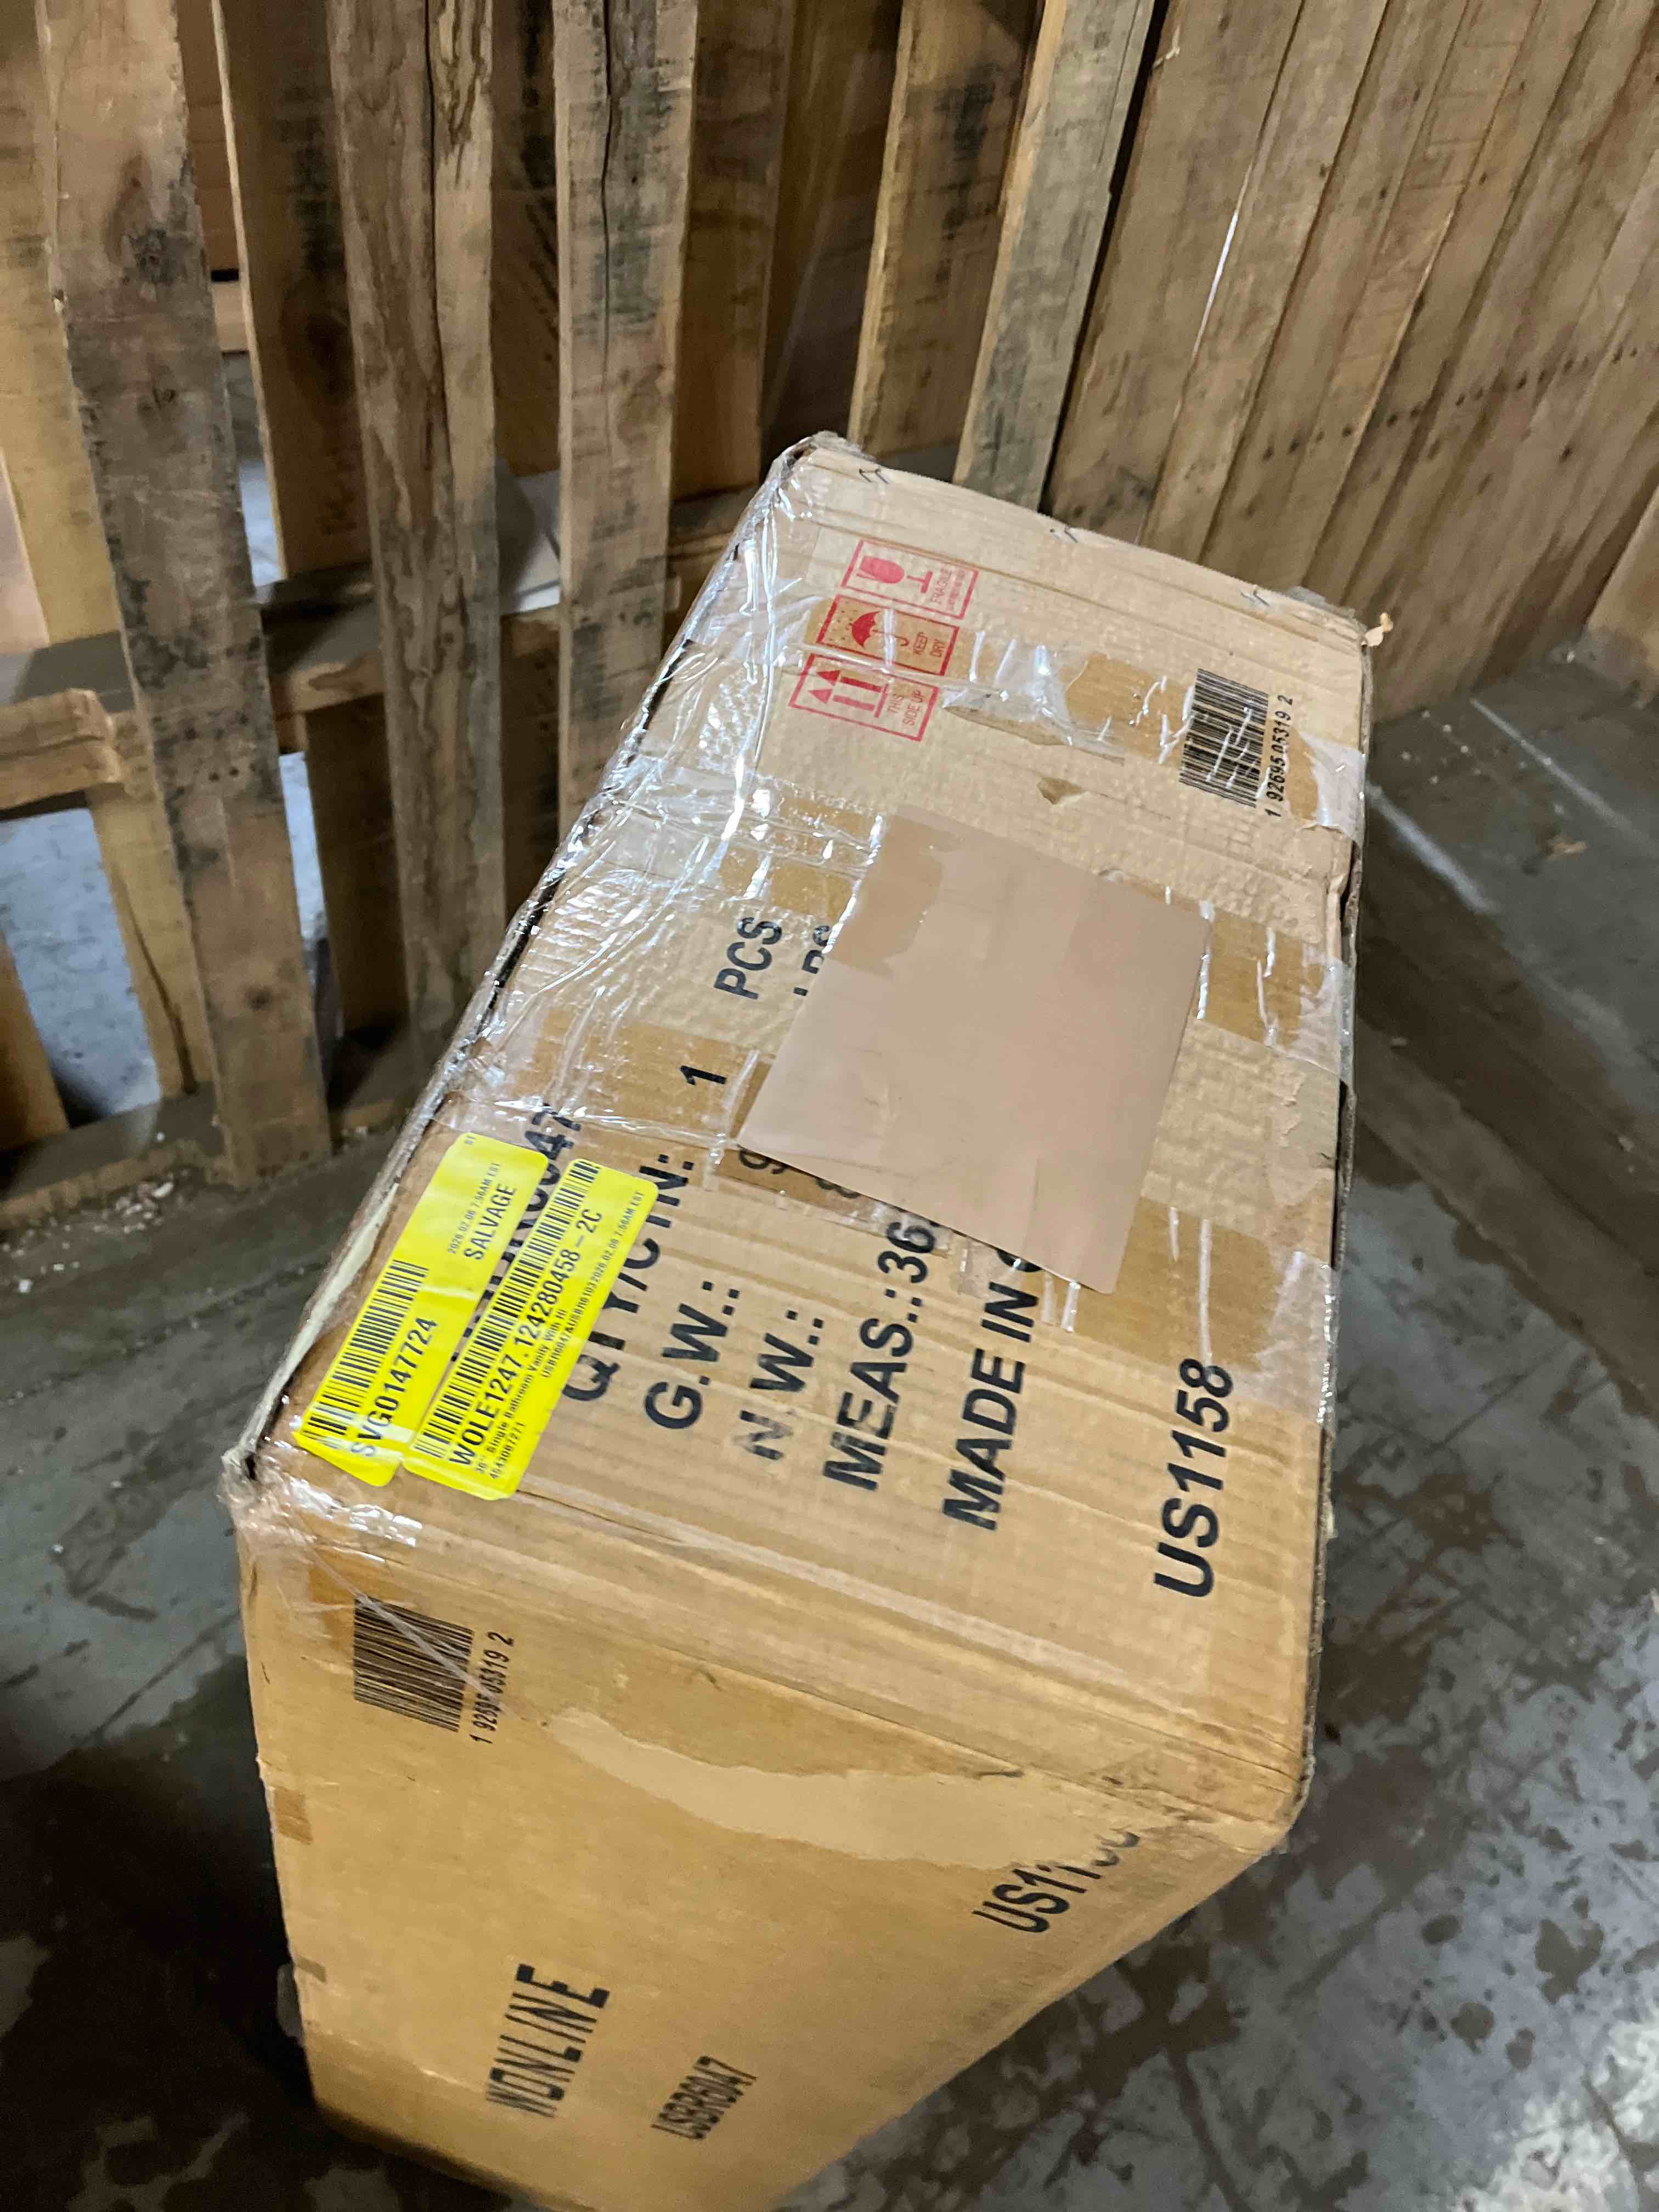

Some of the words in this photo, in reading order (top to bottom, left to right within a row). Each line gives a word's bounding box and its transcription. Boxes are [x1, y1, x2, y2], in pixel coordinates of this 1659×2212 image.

[913, 632, 928, 656] KEEP
[930, 639, 945, 658] DRY
[887, 693, 904, 714] THIS
[902, 702, 919, 726] SIDE
[913, 689, 923, 703] UP
[1277, 695, 1293, 706] 2
[1271, 710, 1291, 754] 05319
[1266, 755, 1285, 801] 92695
[1265, 808, 1282, 817] 1
[680, 1065, 727, 1085] 1
[714, 917, 782, 1000] PCS
[464, 1183, 518, 1260] SALVAGE
[981, 1281, 1039, 1344] IN
[526, 1345, 549, 1372] Vanity
[544, 1322, 561, 1341] With
[644, 1282, 740, 1429] G.W.:
[351, 1316, 438, 1457] SVG0147724
[732, 1309, 824, 1460] NW.:
[941, 1348, 1028, 1531] MADE
[1153, 1358, 1234, 1598] US1158
[470, 1734, 493, 1745] 1
[487, 1632, 515, 1646] 2
